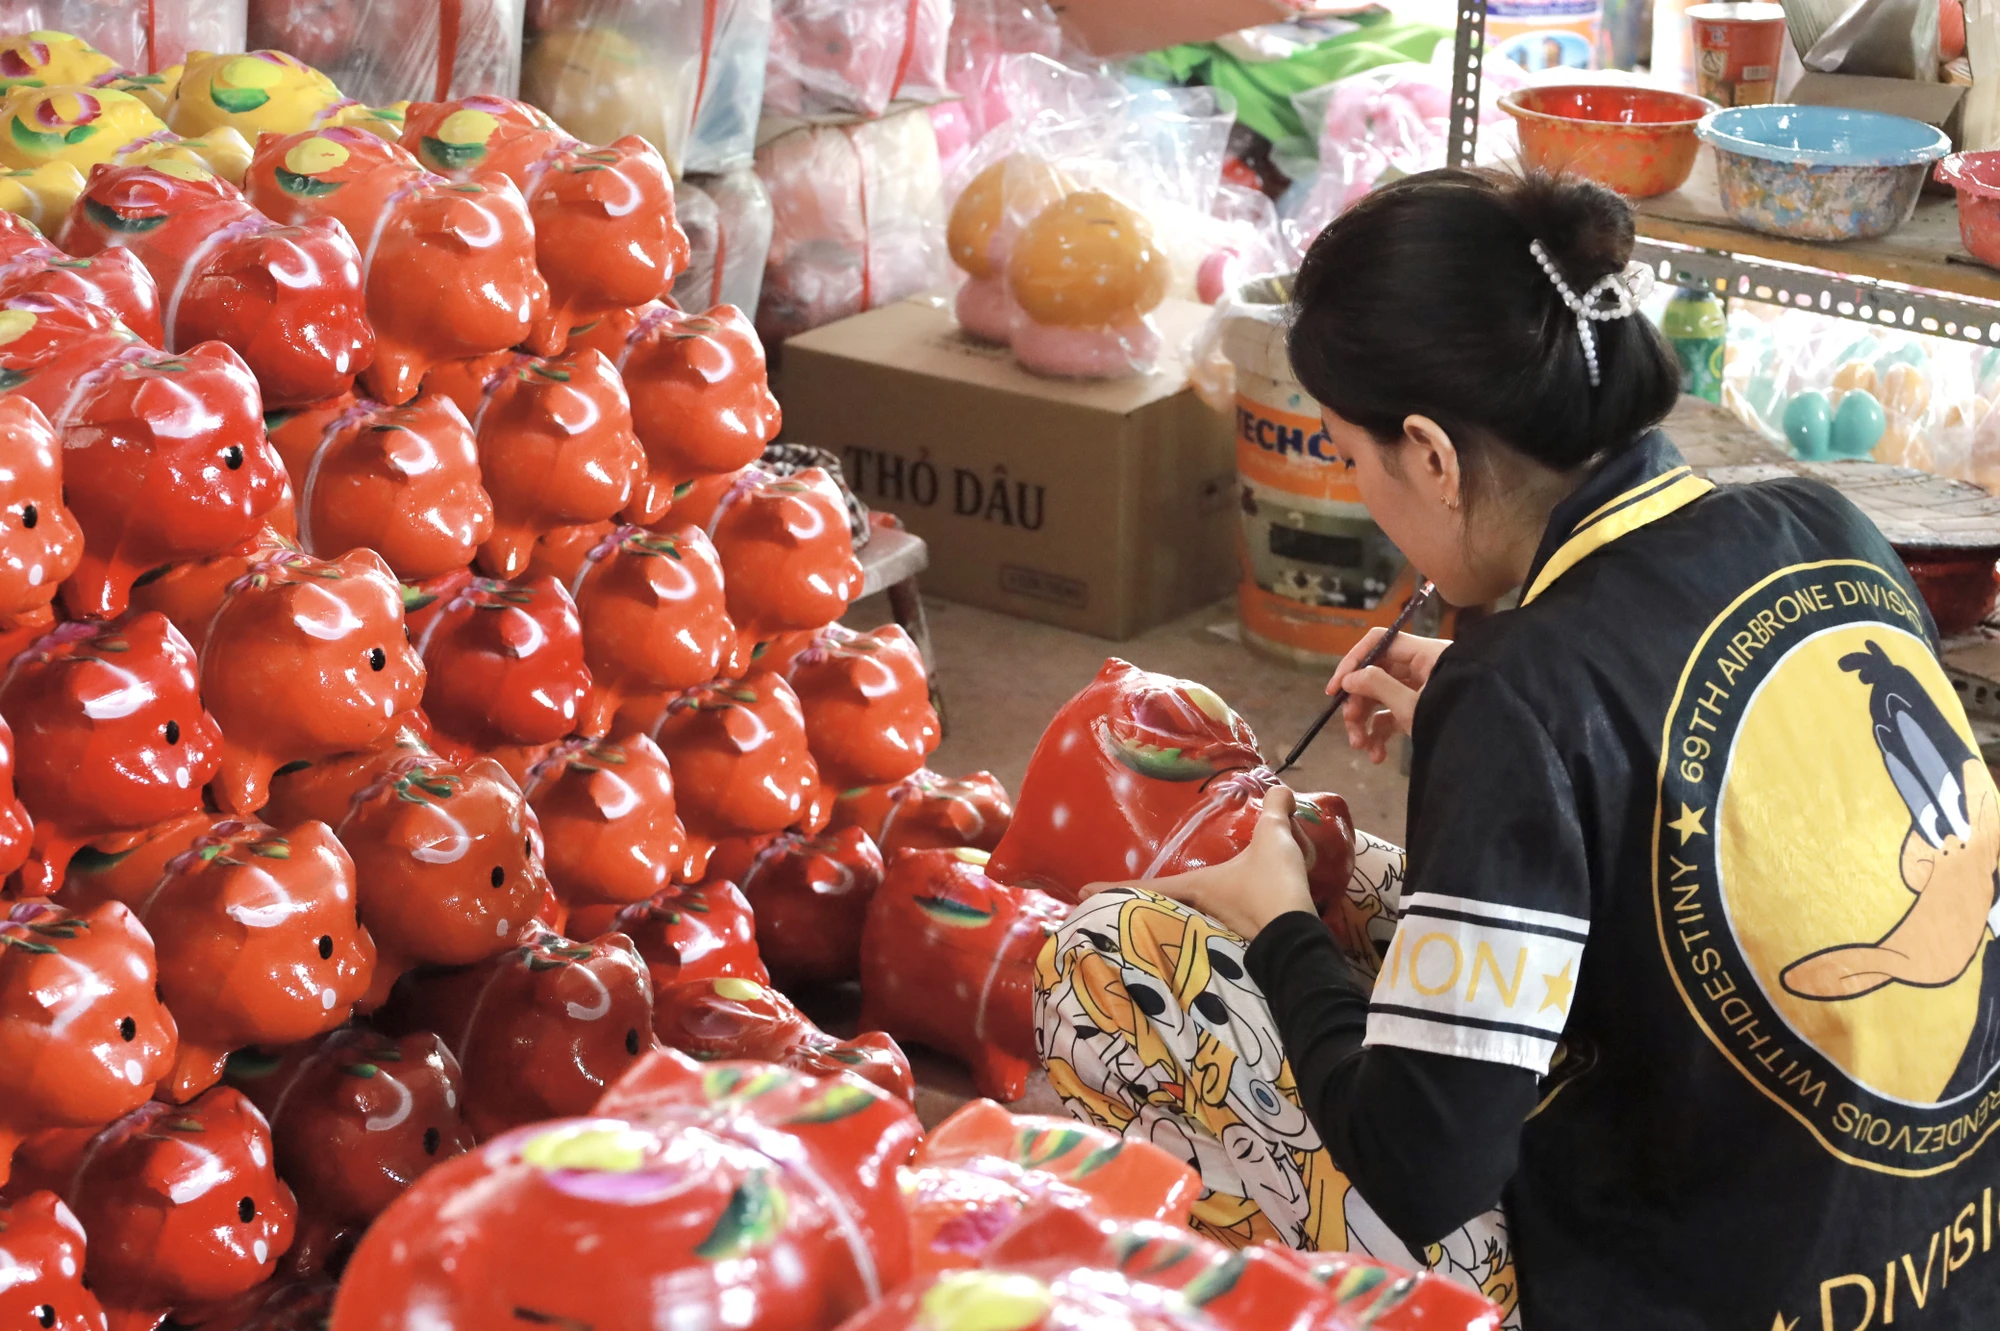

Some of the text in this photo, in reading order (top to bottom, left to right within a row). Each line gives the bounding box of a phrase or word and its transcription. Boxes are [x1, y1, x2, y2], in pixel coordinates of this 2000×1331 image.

[845, 446, 939, 507] THỎ
[1680, 681, 1730, 783] 69TH
[1717, 584, 1834, 686] AIRBRONE
[1374, 928, 1528, 1009] ION
[1820, 1187, 2000, 1331] DIVISI
